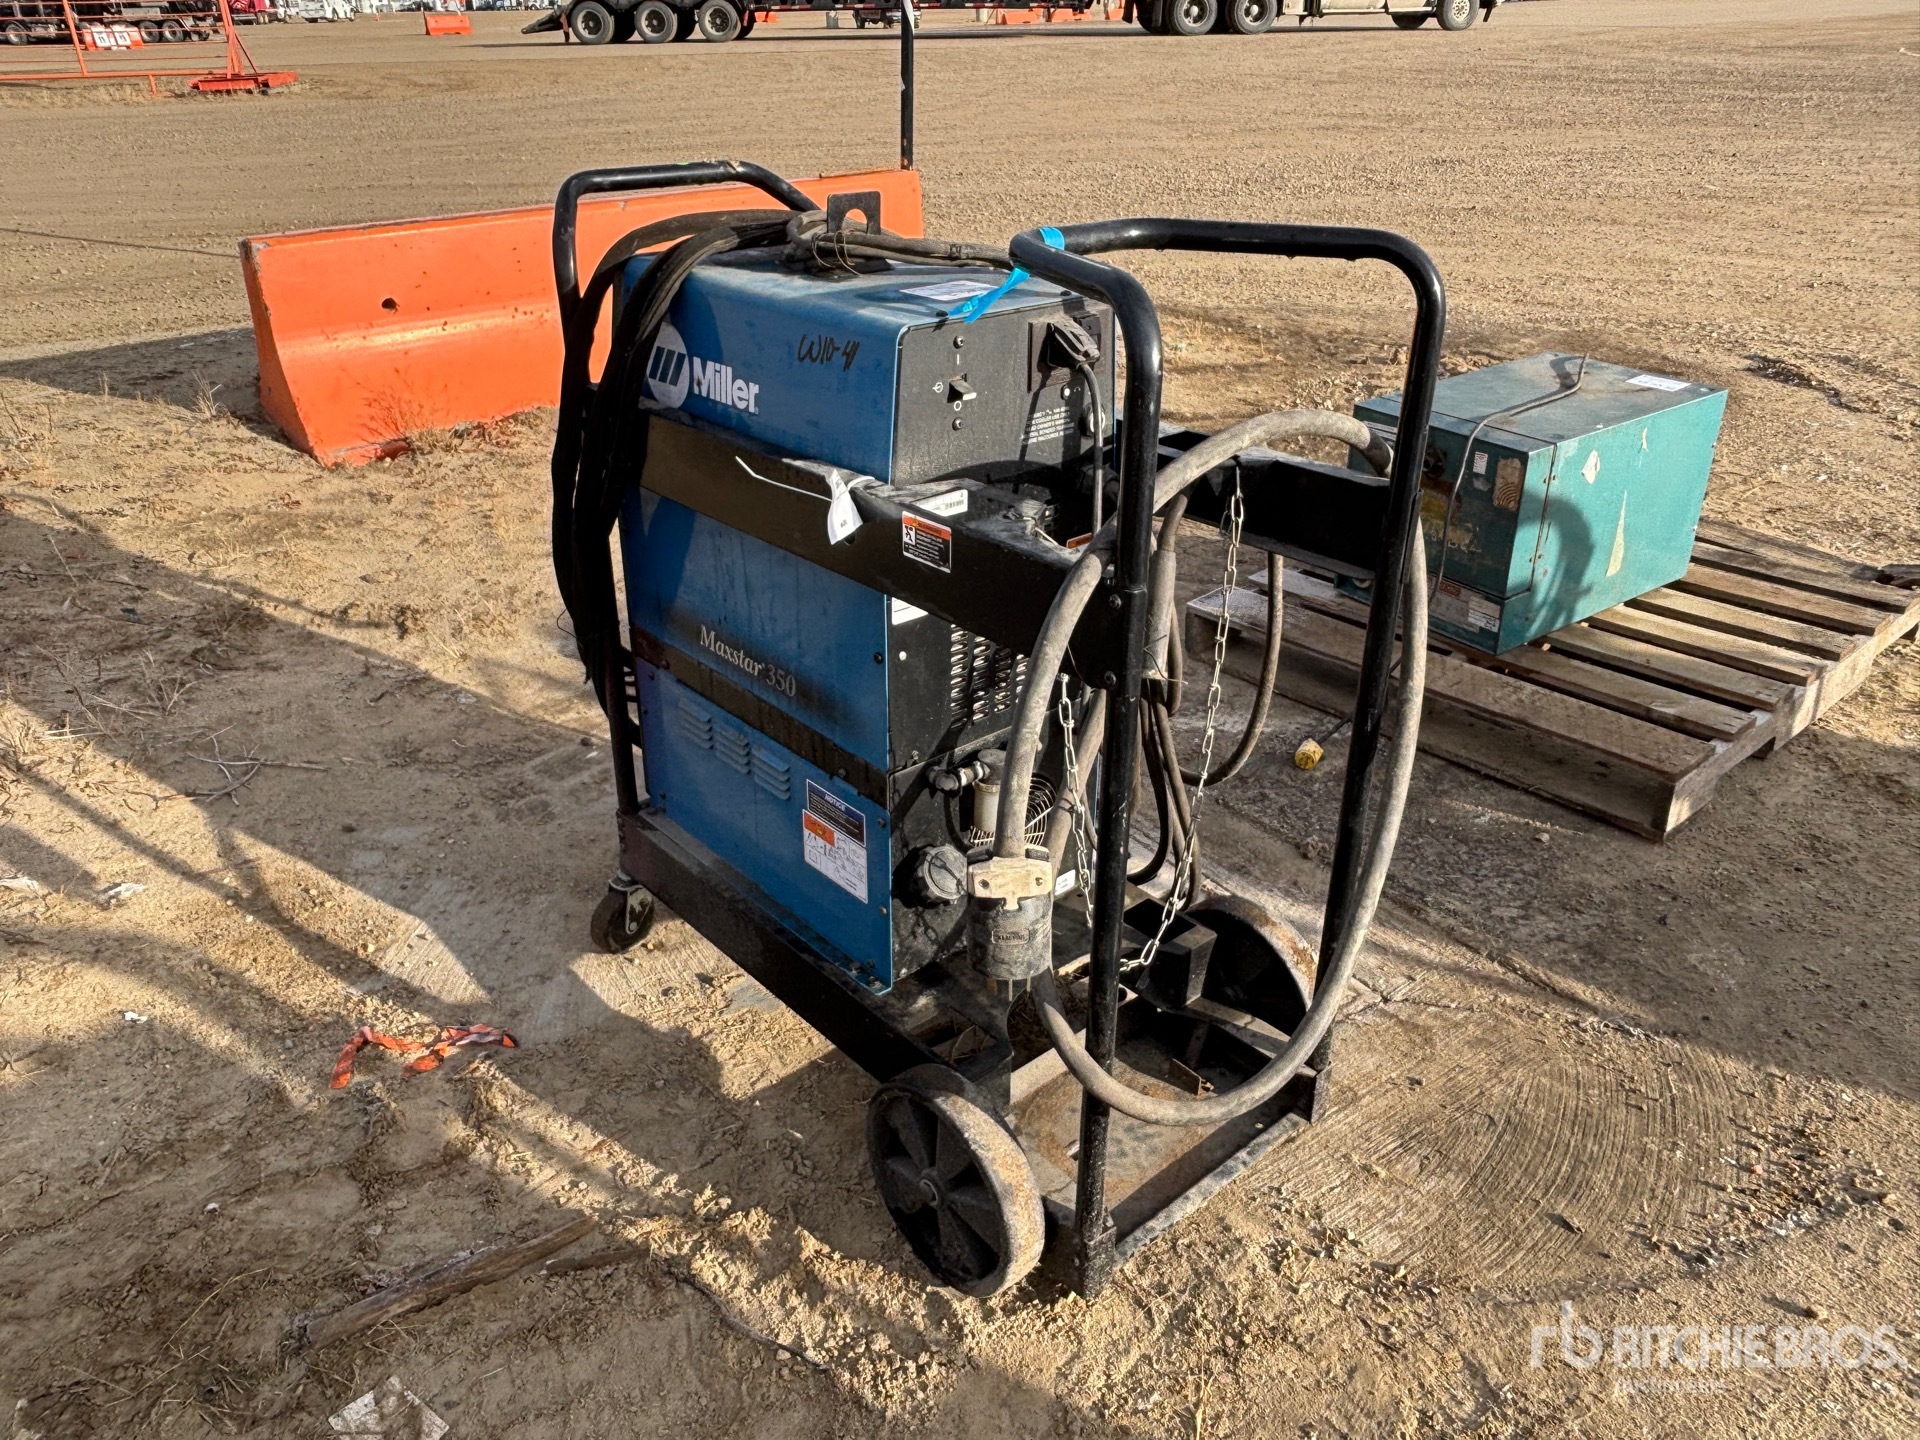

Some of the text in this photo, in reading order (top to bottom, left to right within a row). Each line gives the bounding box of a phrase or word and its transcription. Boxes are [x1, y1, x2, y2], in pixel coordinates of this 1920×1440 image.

[693, 356, 759, 414] Miller
[700, 624, 796, 697] Maxstar 350
